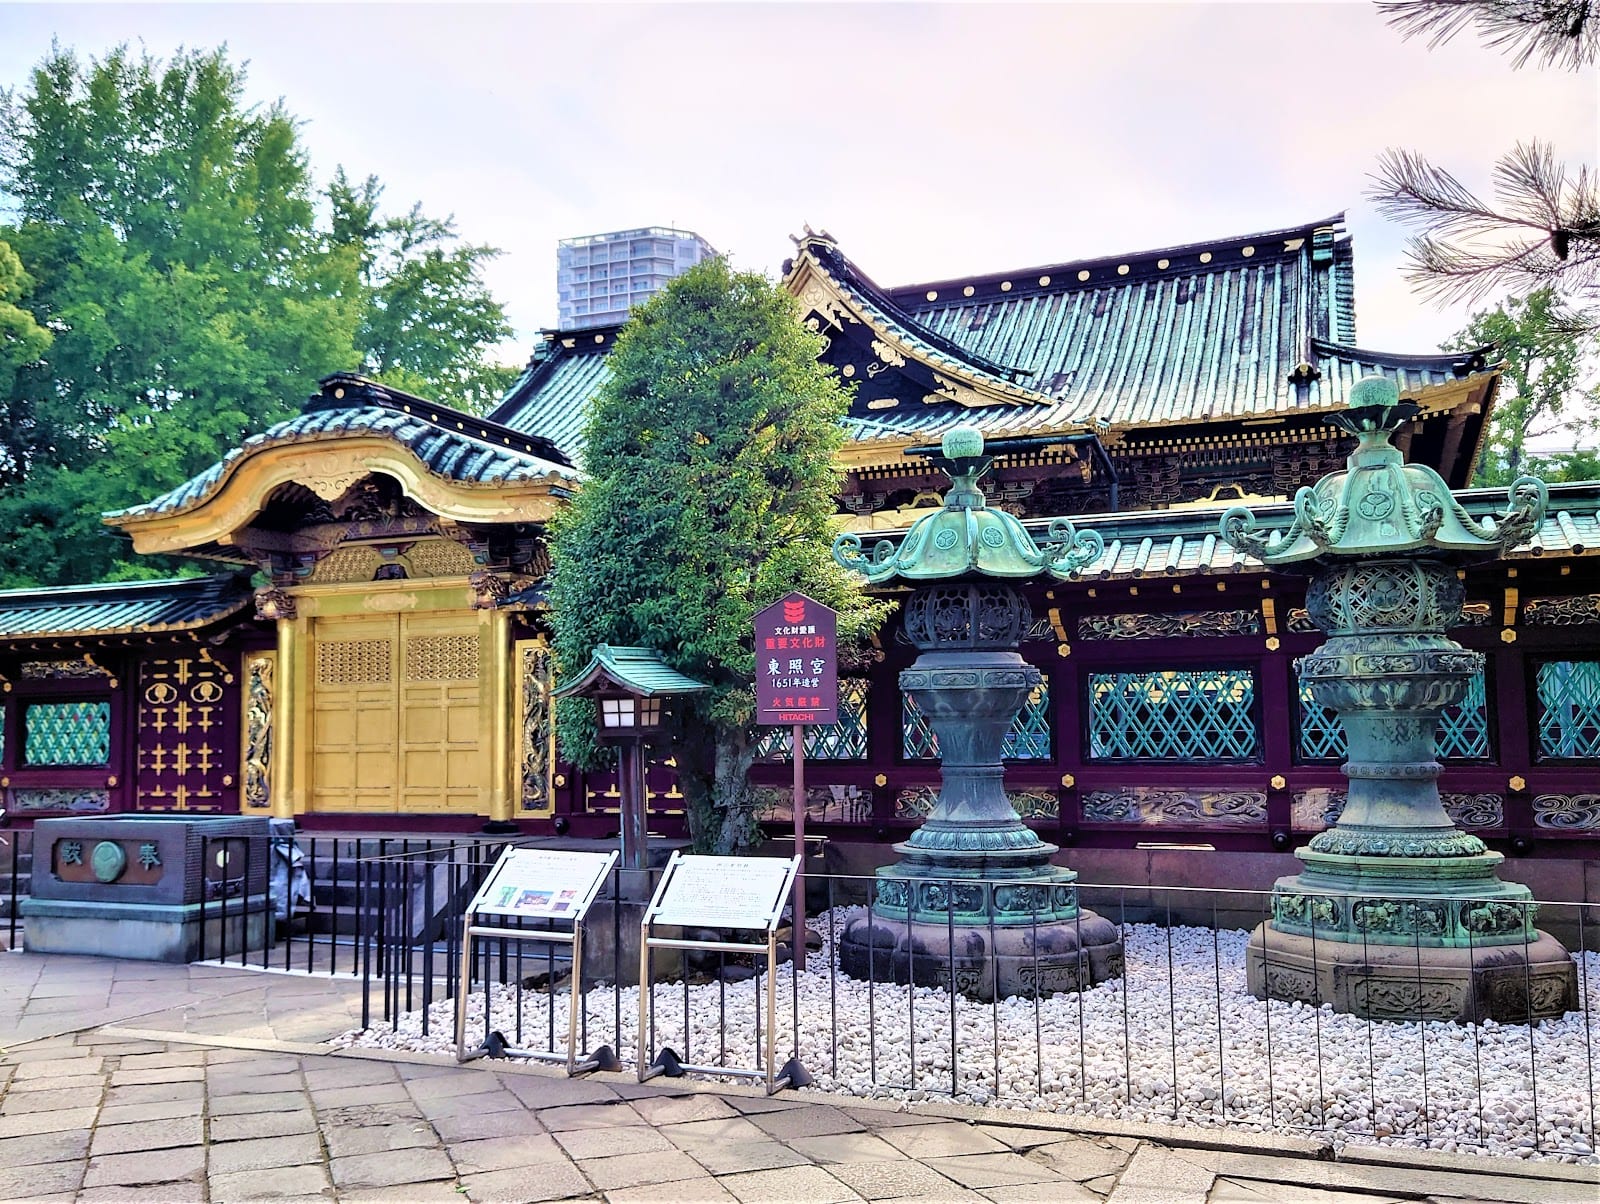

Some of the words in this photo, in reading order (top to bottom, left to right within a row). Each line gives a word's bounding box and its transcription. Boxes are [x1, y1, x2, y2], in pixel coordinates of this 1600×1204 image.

[766, 637, 826, 649] 重要文化財
[767, 658, 826, 675] 東照宮
[771, 678, 820, 688] 1651年造営
[778, 713, 815, 721] HITACHI
